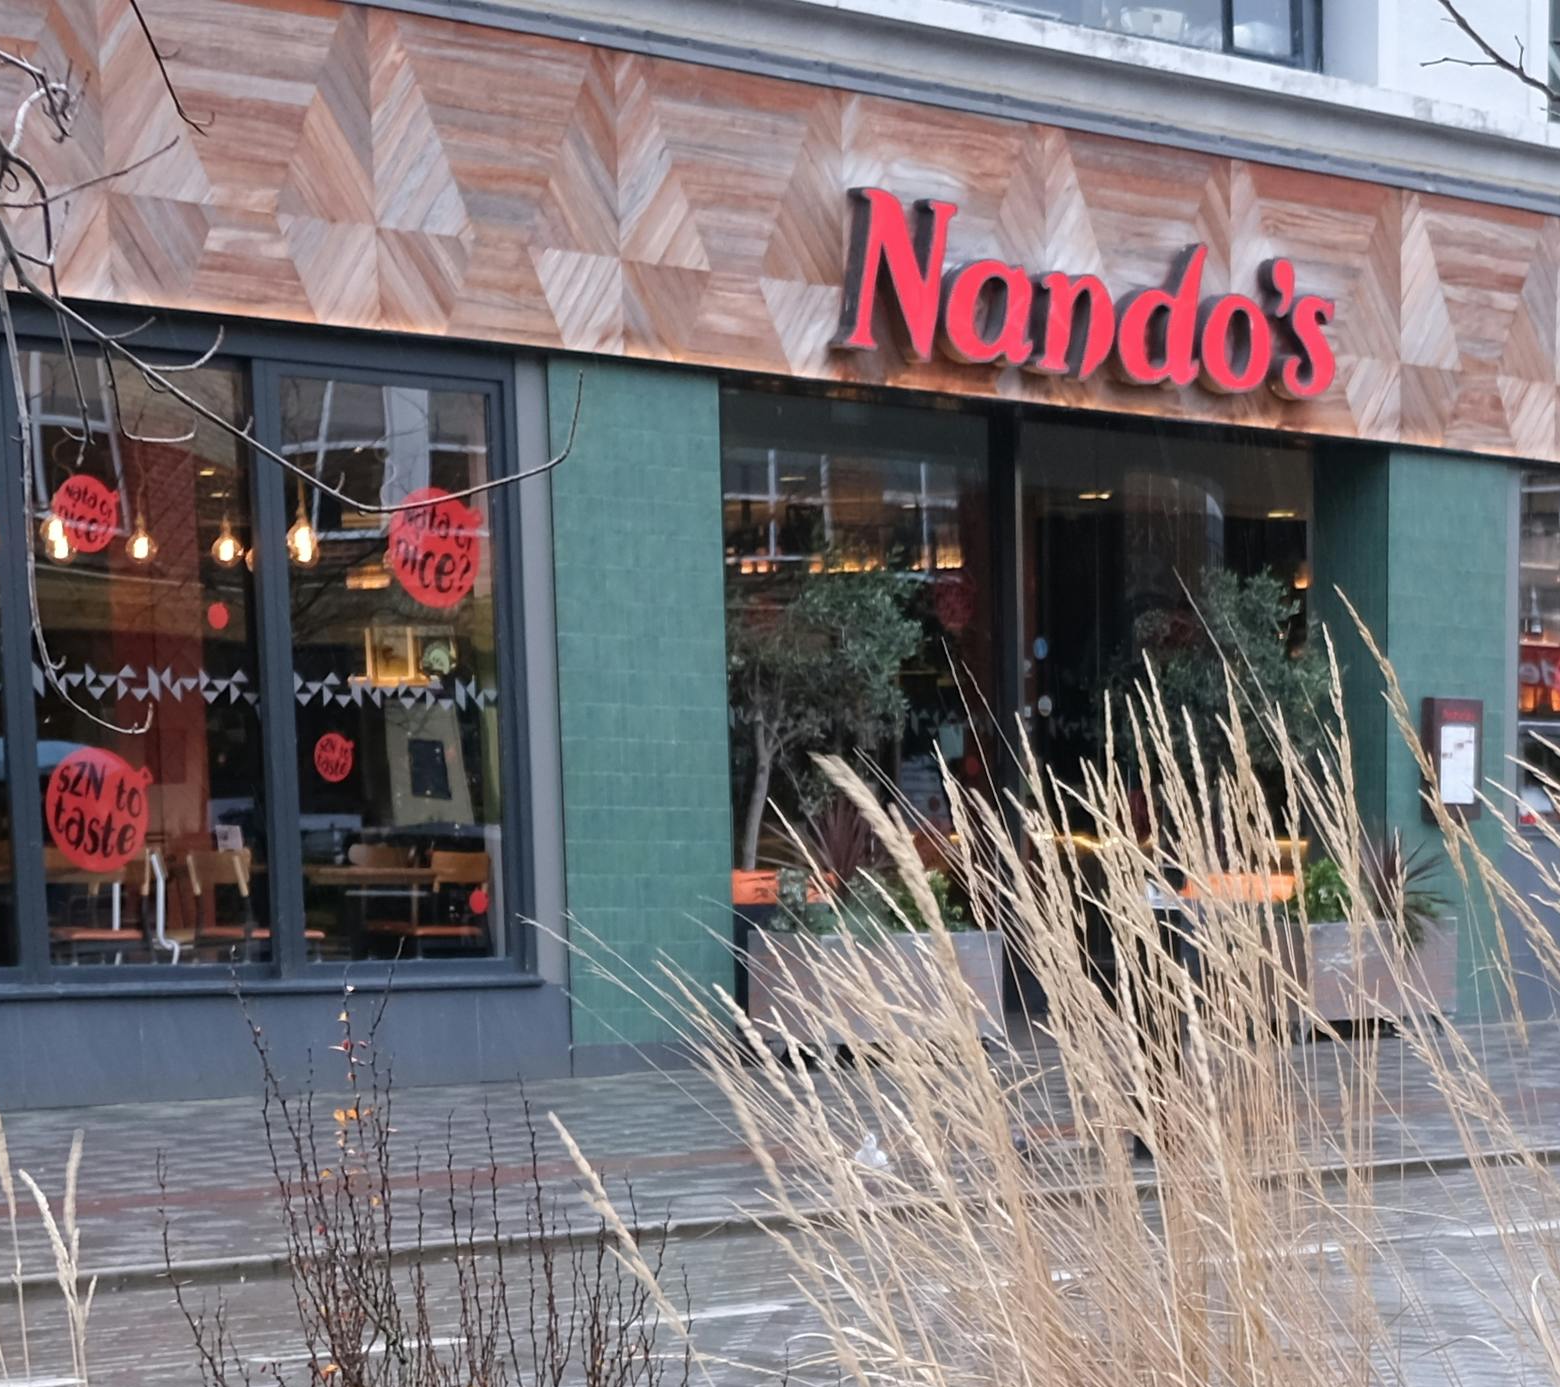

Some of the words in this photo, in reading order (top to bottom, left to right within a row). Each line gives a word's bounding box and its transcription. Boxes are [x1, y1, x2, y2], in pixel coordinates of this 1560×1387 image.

[840, 186, 1336, 398] Nando's
[53, 795, 137, 858] taste
[116, 777, 142, 817] to
